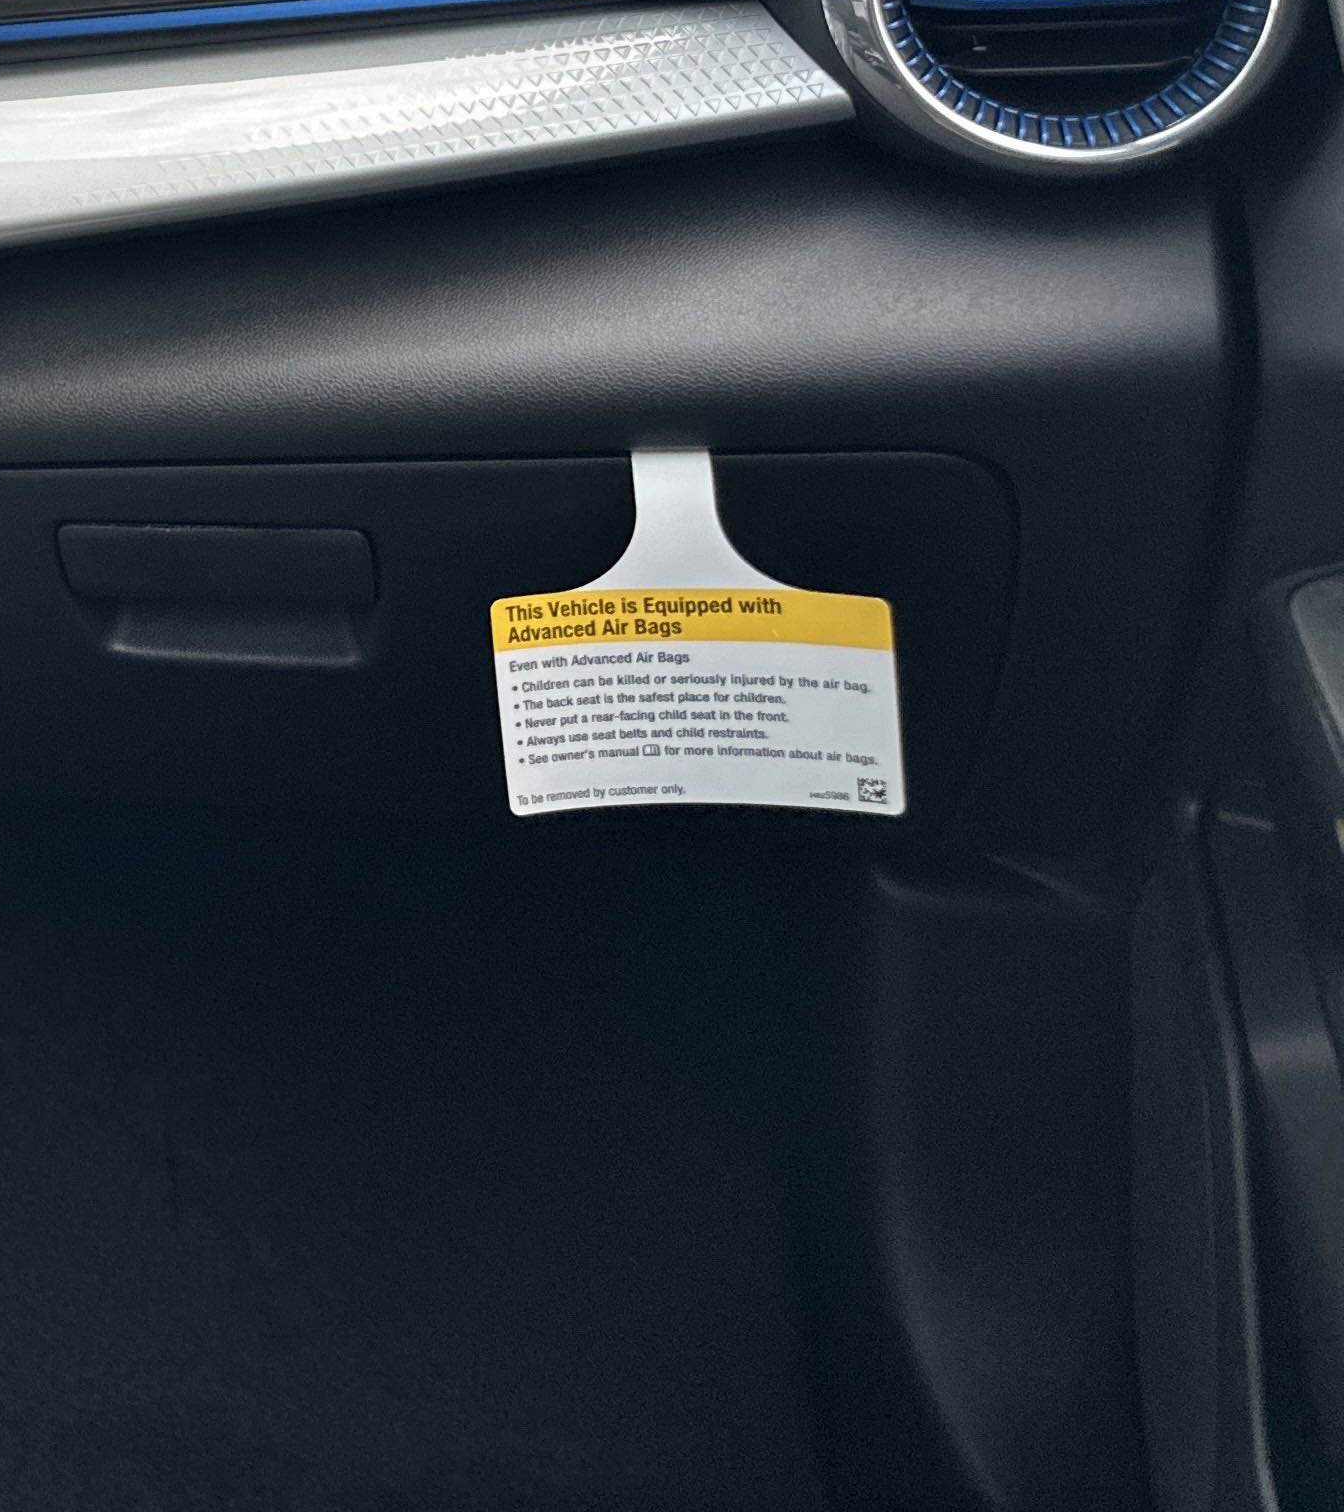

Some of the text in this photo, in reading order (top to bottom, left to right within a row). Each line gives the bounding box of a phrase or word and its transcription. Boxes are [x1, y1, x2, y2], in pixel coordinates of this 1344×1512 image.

[506, 597, 782, 622] This Vehicle is Equipped with
[508, 619, 682, 643] Advanced Air Bags
[509, 651, 689, 673] Even with Advanced Air Bags
[522, 673, 871, 694] Children can be killed or seriously injured by the air bag.
[523, 691, 786, 710] The back seat is the safest place for children.
[525, 709, 789, 728] Never put a rear-facing child seat in the front.
[526, 727, 768, 748] Always use seat belts and child restraints.
[528, 744, 879, 766] See owner's manual for more information about air bags.
[517, 784, 686, 806] To be removed by customer only.
